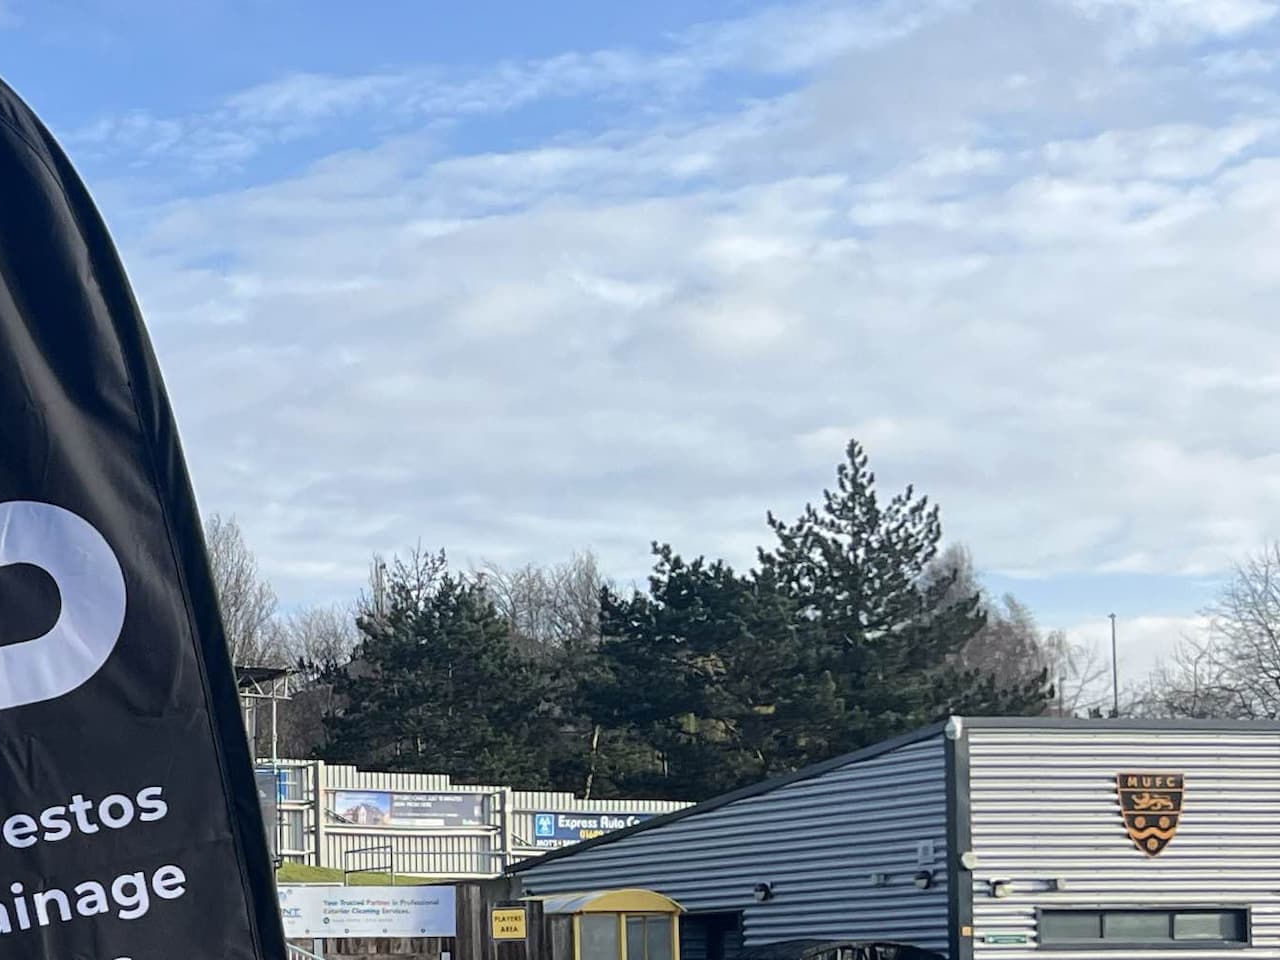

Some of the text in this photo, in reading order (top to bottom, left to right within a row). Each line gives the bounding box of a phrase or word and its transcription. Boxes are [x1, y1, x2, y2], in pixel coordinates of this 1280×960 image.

[1127, 776, 1175, 788] MUFC
[557, 815, 597, 830] Express
[601, 816, 625, 829] Auto
